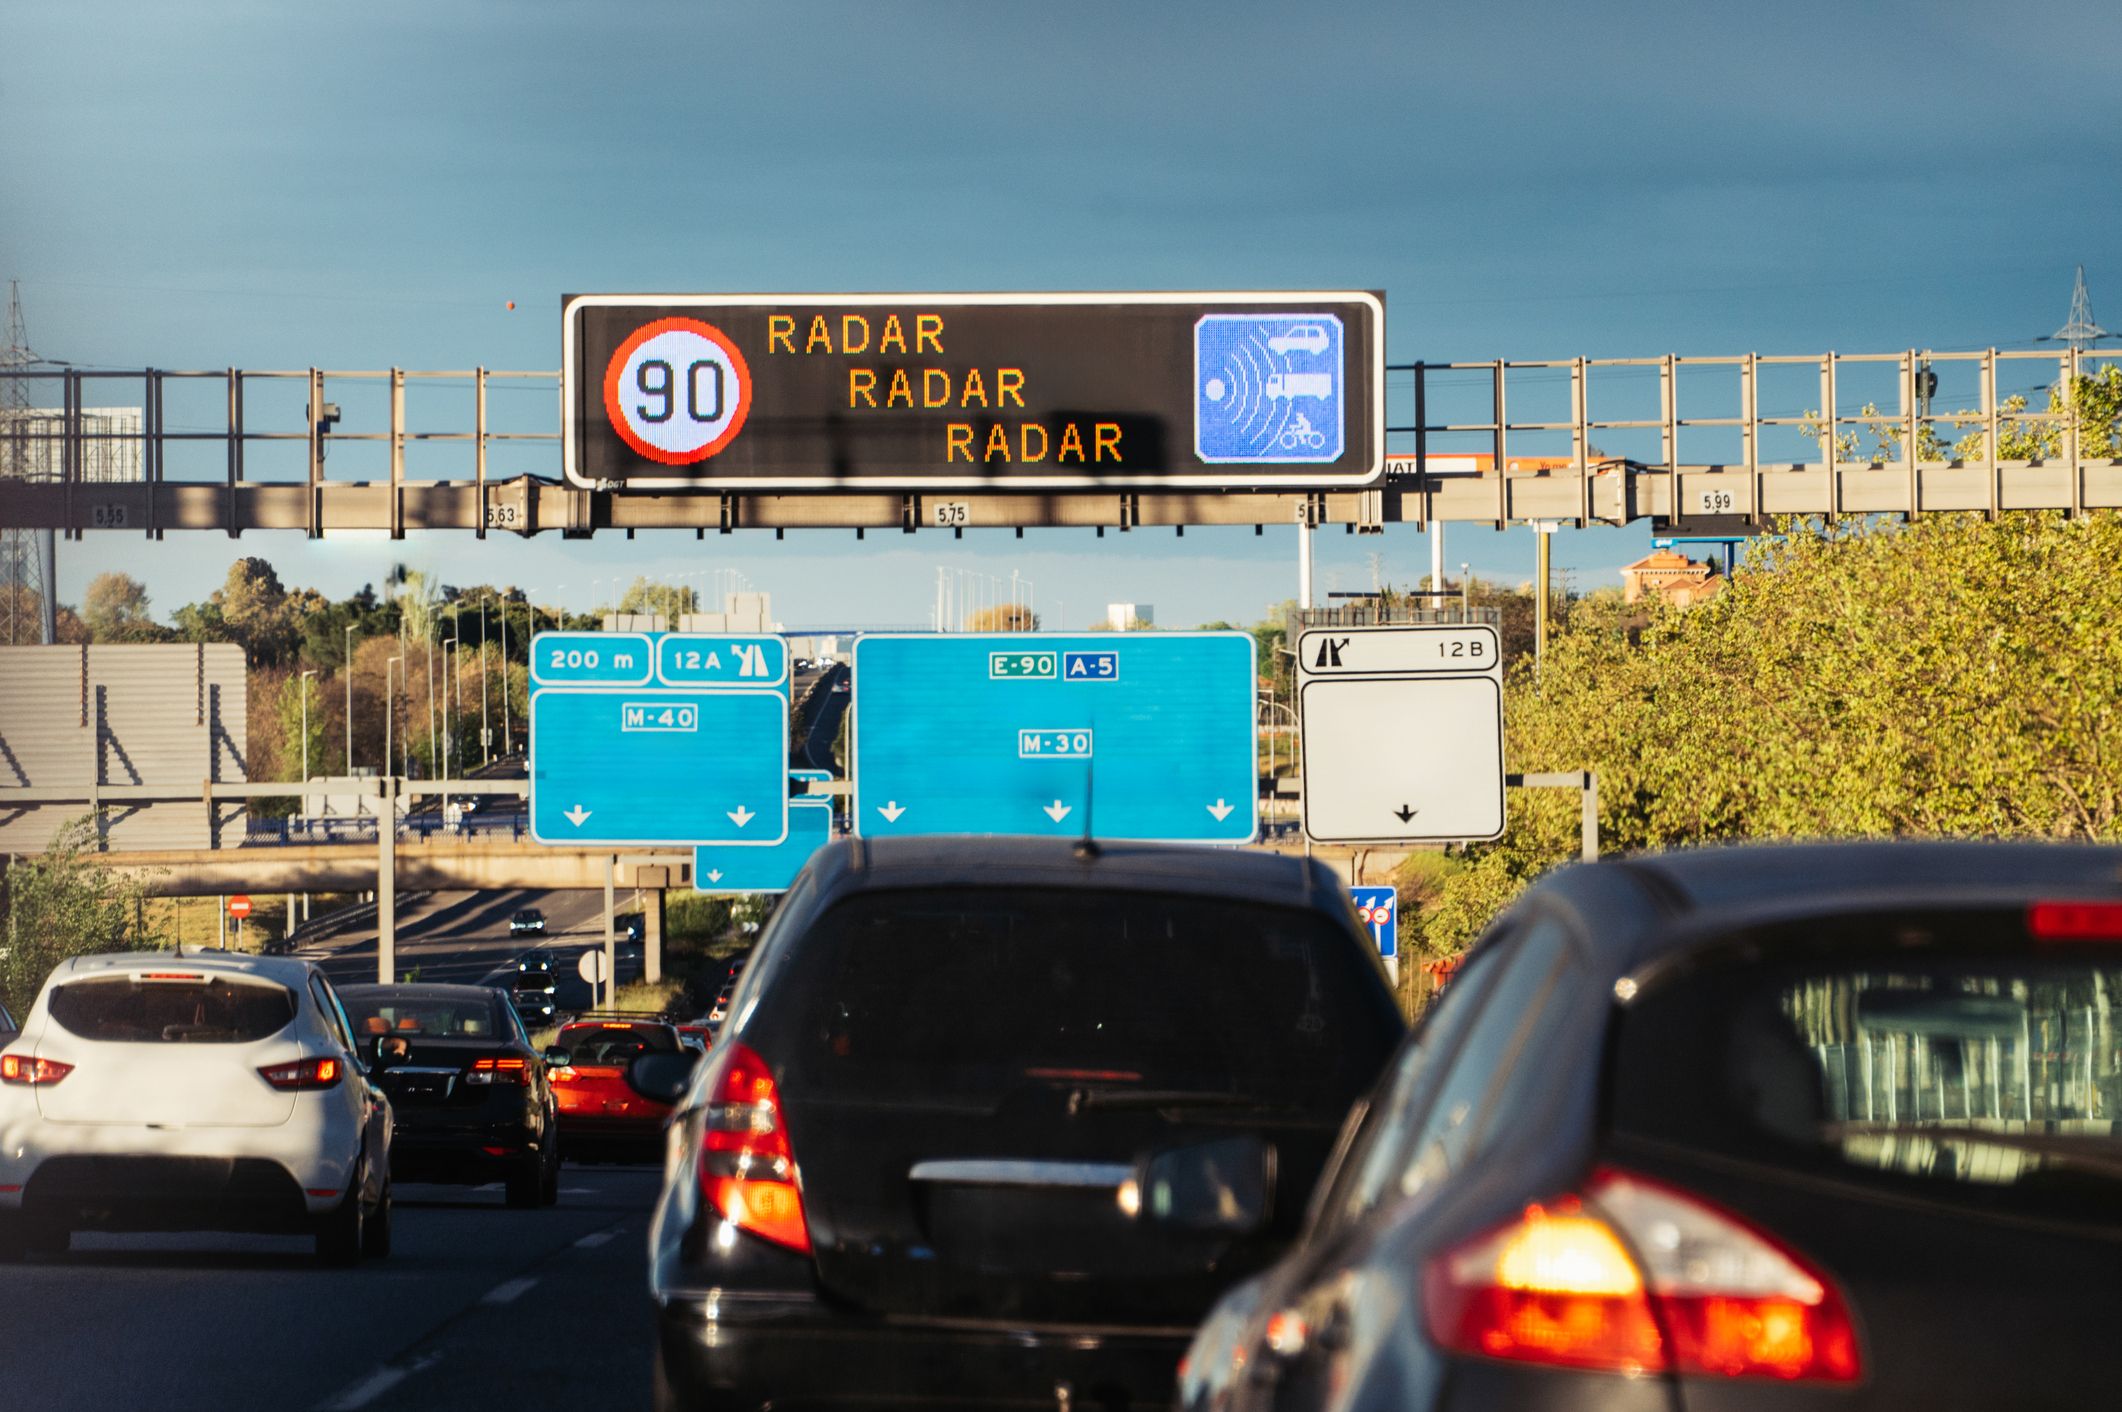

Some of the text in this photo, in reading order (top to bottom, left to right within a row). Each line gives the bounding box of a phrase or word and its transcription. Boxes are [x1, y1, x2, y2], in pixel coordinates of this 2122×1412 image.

[768, 314, 944, 354] RADAR
[636, 359, 724, 423] 90
[850, 368, 1025, 408] RADAR
[947, 423, 1122, 463] RADAR
[1704, 494, 1731, 510] 5,99
[487, 507, 515, 524] 5,63
[938, 506, 966, 523] 5,75
[551, 650, 634, 669] 200 m
[674, 651, 722, 669] 12A
[994, 656, 1052, 675] E-90
[1070, 657, 1113, 676] A-5
[627, 708, 694, 727] M-40
[1024, 734, 1088, 753] M-30
